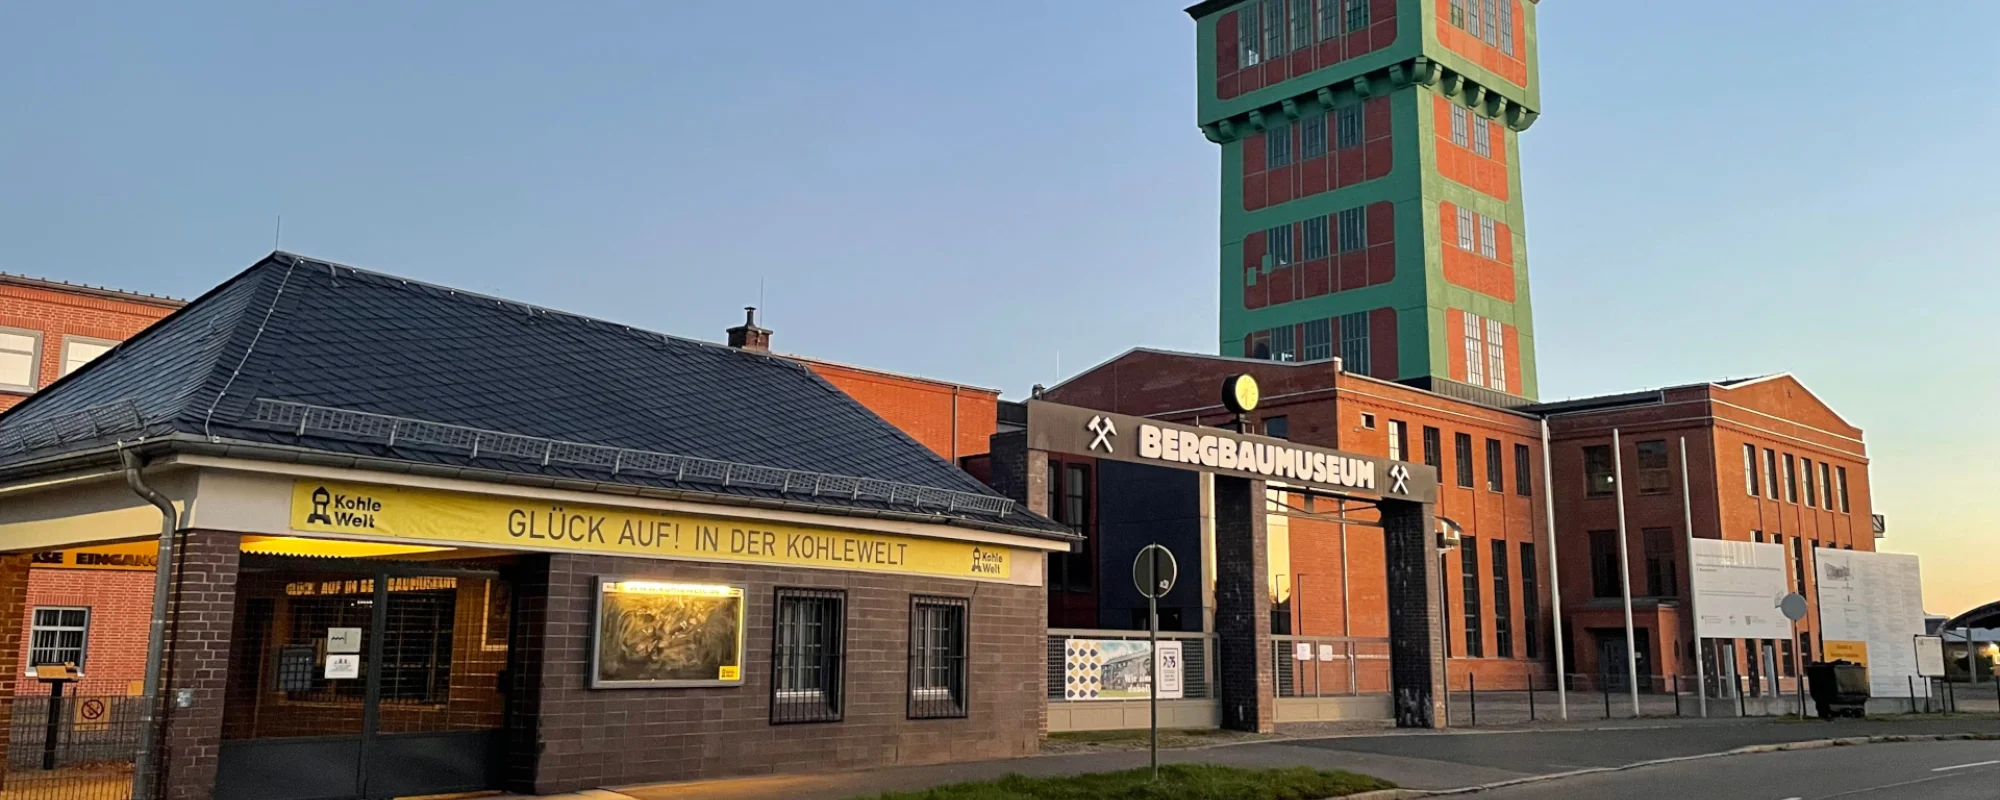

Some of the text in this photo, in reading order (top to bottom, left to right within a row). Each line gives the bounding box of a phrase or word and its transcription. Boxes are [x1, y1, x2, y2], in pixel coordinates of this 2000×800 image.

[1139, 424, 1375, 489] BERGBAUMUSEUM
[334, 494, 382, 512] Kohle
[334, 511, 375, 528] Welt
[508, 507, 908, 566] GLÜCK AUF! IN DER KOHLEWELT
[982, 552, 1003, 563] Kohle
[982, 563, 1001, 574] Welt
